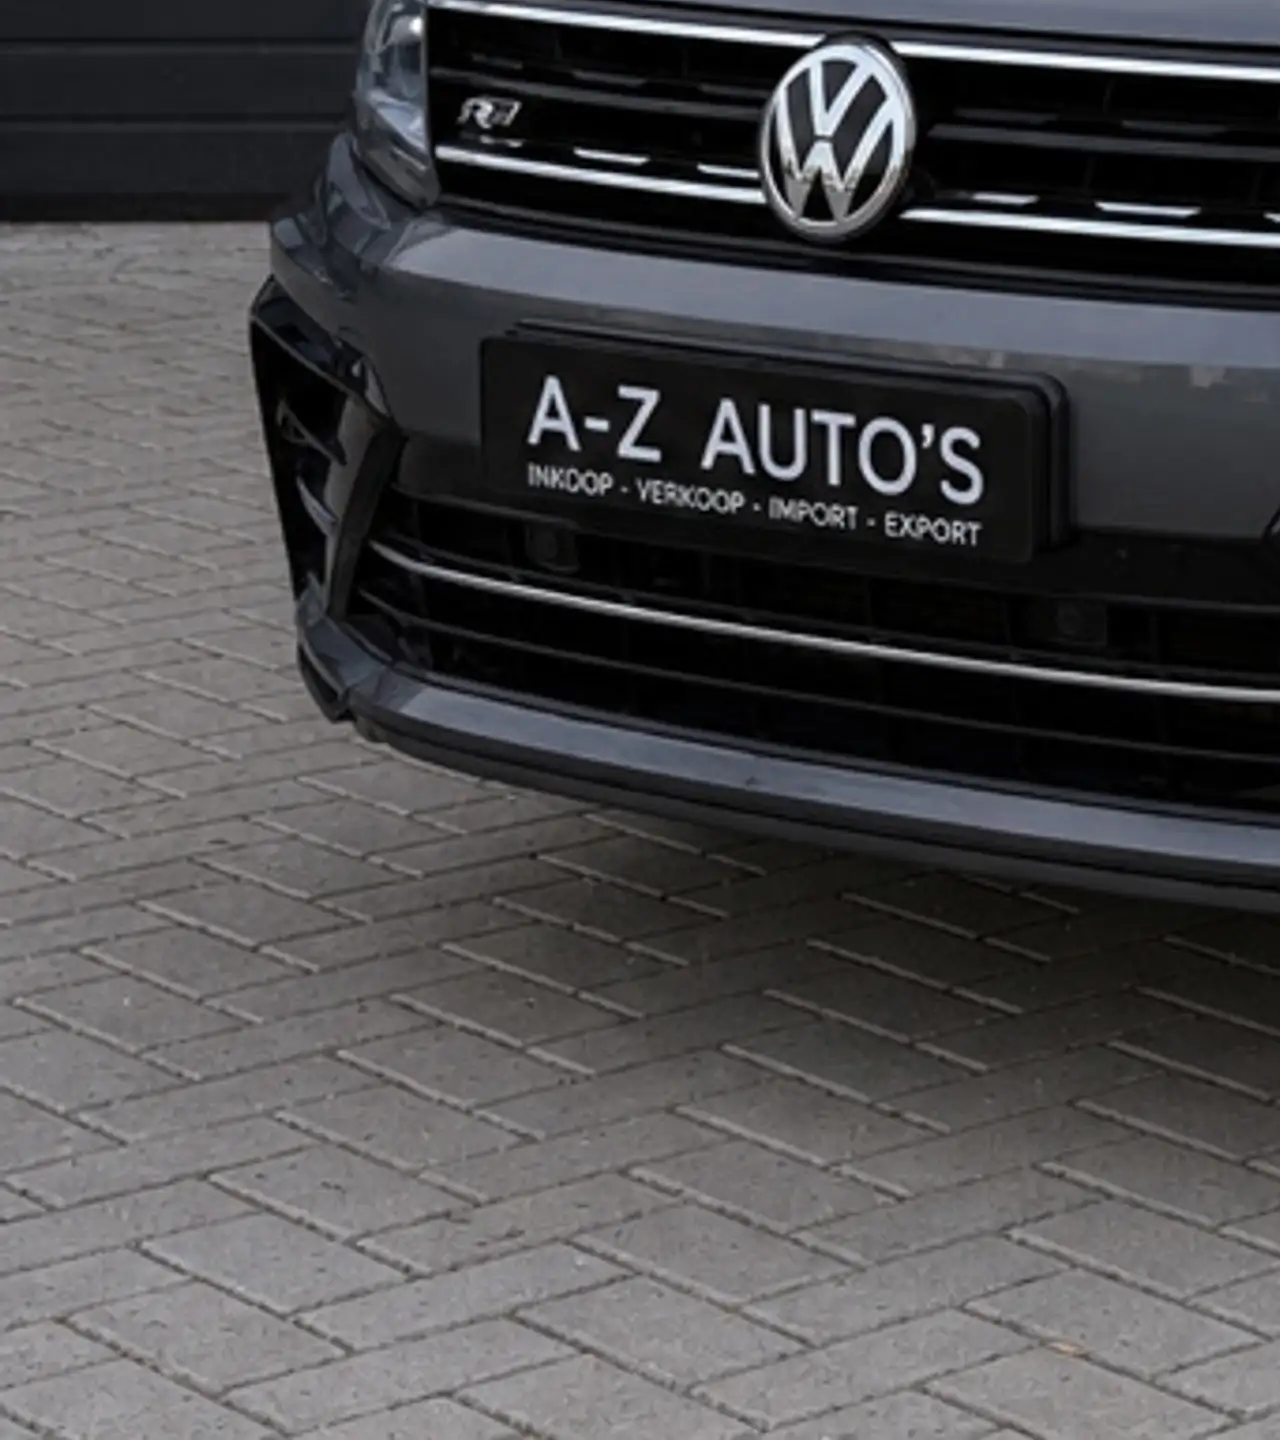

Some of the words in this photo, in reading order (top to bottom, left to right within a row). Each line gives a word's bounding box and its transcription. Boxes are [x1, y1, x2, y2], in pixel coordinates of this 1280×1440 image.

[527, 374, 662, 463] A-Z
[701, 397, 984, 505] AUTO'S
[527, 462, 613, 496] INKOOP
[635, 478, 746, 515] VERKOOP
[768, 495, 858, 530] IMPORT
[884, 511, 982, 547] EXPORT
